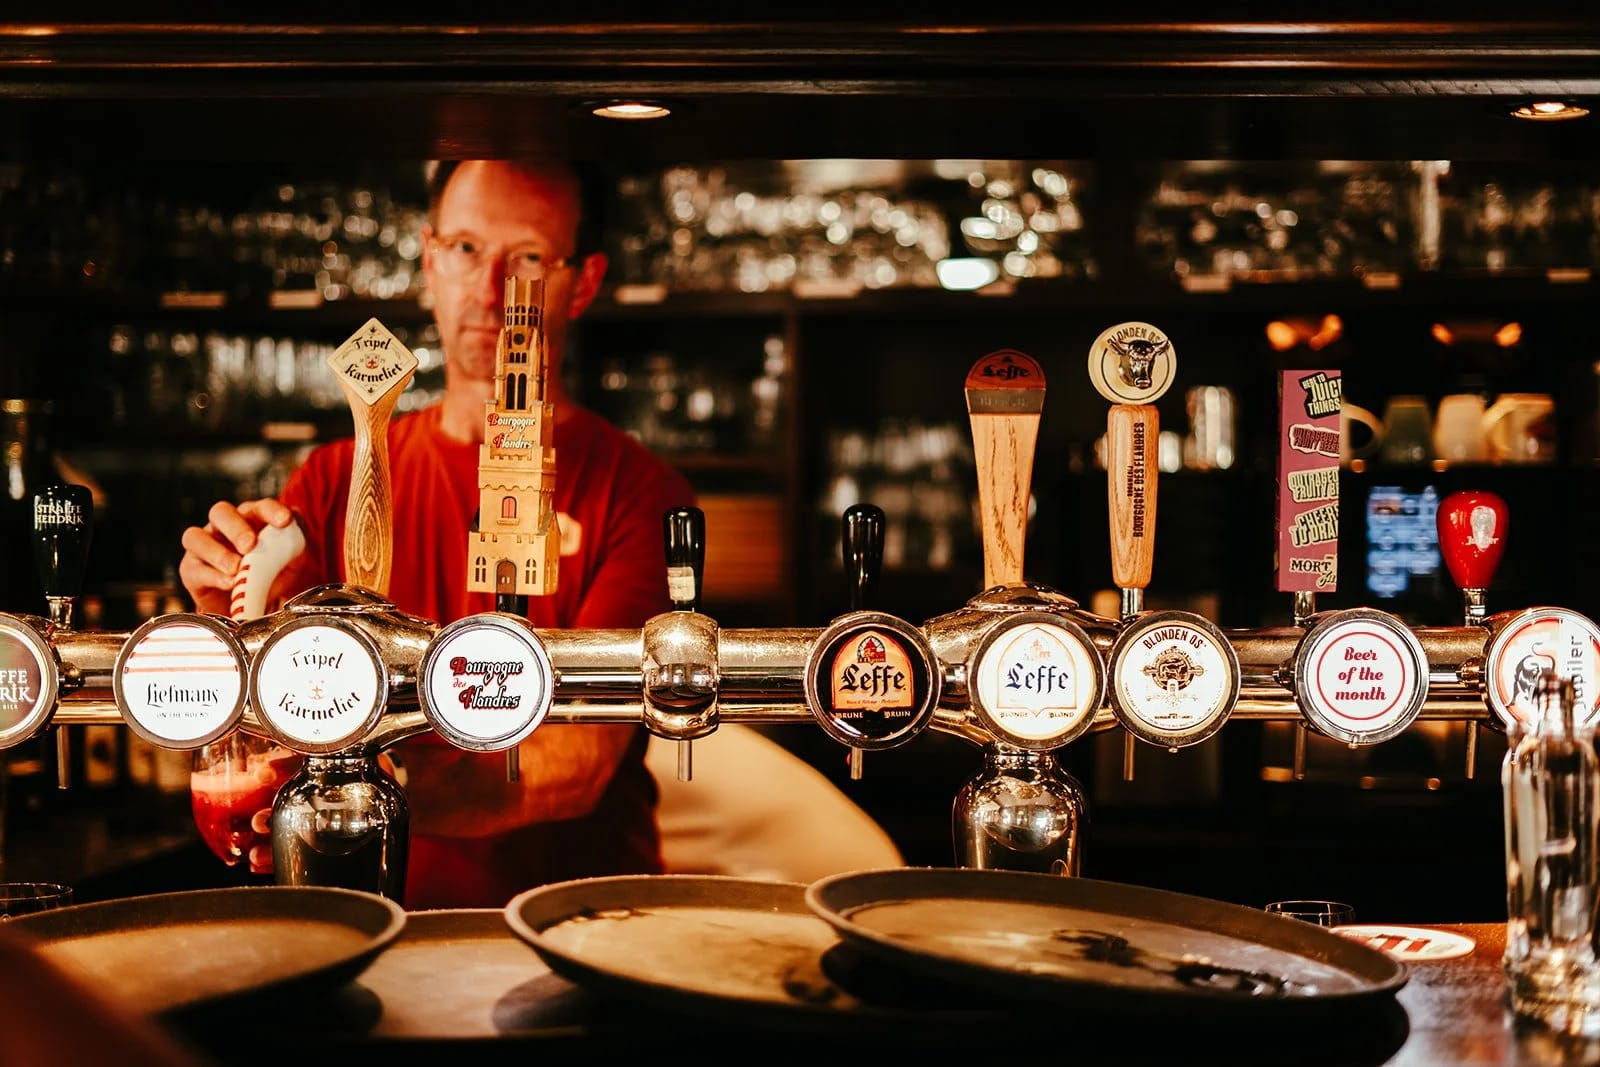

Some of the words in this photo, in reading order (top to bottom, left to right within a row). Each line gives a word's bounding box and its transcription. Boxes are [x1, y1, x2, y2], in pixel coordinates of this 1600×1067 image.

[351, 336, 391, 350] Tripel
[344, 363, 402, 382] Karmeliet
[981, 364, 1031, 380] Leffe
[1316, 373, 1326, 383] TO
[1307, 398, 1340, 415] THINGS
[487, 413, 536, 433] Bourgogne
[493, 432, 535, 449] Flandres
[1134, 422, 1145, 467] FLANDRES
[1134, 469, 1145, 485] DES
[1295, 482, 1327, 500] FRUITY
[1133, 486, 1144, 537] BOURGOGNE
[1290, 527, 1310, 546] TO
[1291, 559, 1331, 573] MORT
[1143, 629, 1188, 649] BLONDEN
[1189, 634, 1204, 649] OS
[290, 649, 343, 670] Tripel
[1344, 646, 1377, 661] Beer
[449, 656, 524, 686] Bourgogne
[839, 663, 906, 697] Leffe
[1005, 662, 1069, 694] Leffe
[1338, 666, 1357, 685] of
[1359, 666, 1384, 681] the
[453, 677, 467, 688] des
[147, 683, 219, 708] Liefmans
[458, 685, 521, 710] Flandres
[1335, 686, 1387, 701] month
[279, 692, 361, 720] Karmeliet
